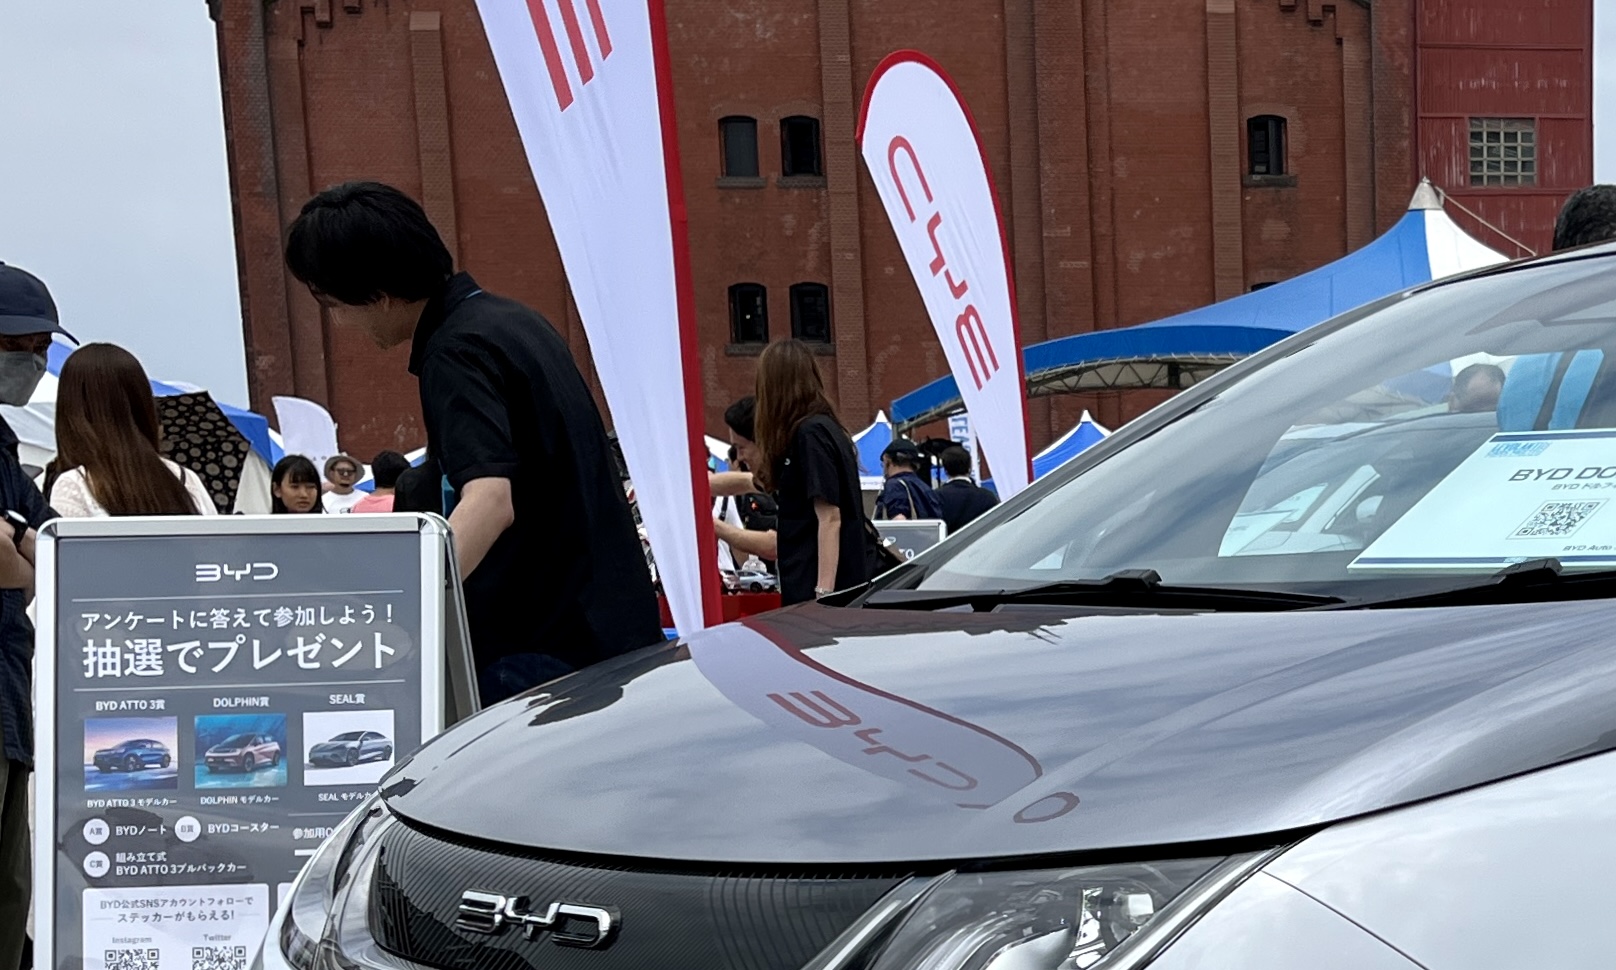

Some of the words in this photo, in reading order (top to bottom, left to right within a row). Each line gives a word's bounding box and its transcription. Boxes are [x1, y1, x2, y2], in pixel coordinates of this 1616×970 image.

[1508, 468, 1574, 482] BYD
[195, 562, 279, 582] BYD
[81, 603, 394, 632] アンケートに答えて参加しよう！
[82, 631, 396, 679] 抽選でプレゼント
[213, 696, 270, 708] DOLPHIN賞
[329, 693, 366, 705] SEAL賞
[95, 700, 118, 712] BYD
[119, 699, 148, 711] ATTO
[200, 795, 239, 805] DOLPHIN
[318, 792, 340, 802] SEAL
[86, 798, 106, 809] BYD
[106, 798, 130, 808] ATTO
[115, 824, 167, 836] BYDノート
[207, 822, 280, 834] BYDコースター
[115, 850, 168, 864] 組み立て式
[115, 865, 139, 876] BYD
[140, 864, 169, 875] ATTO
[455, 889, 616, 948] BYD
[203, 933, 232, 942] Twitter
